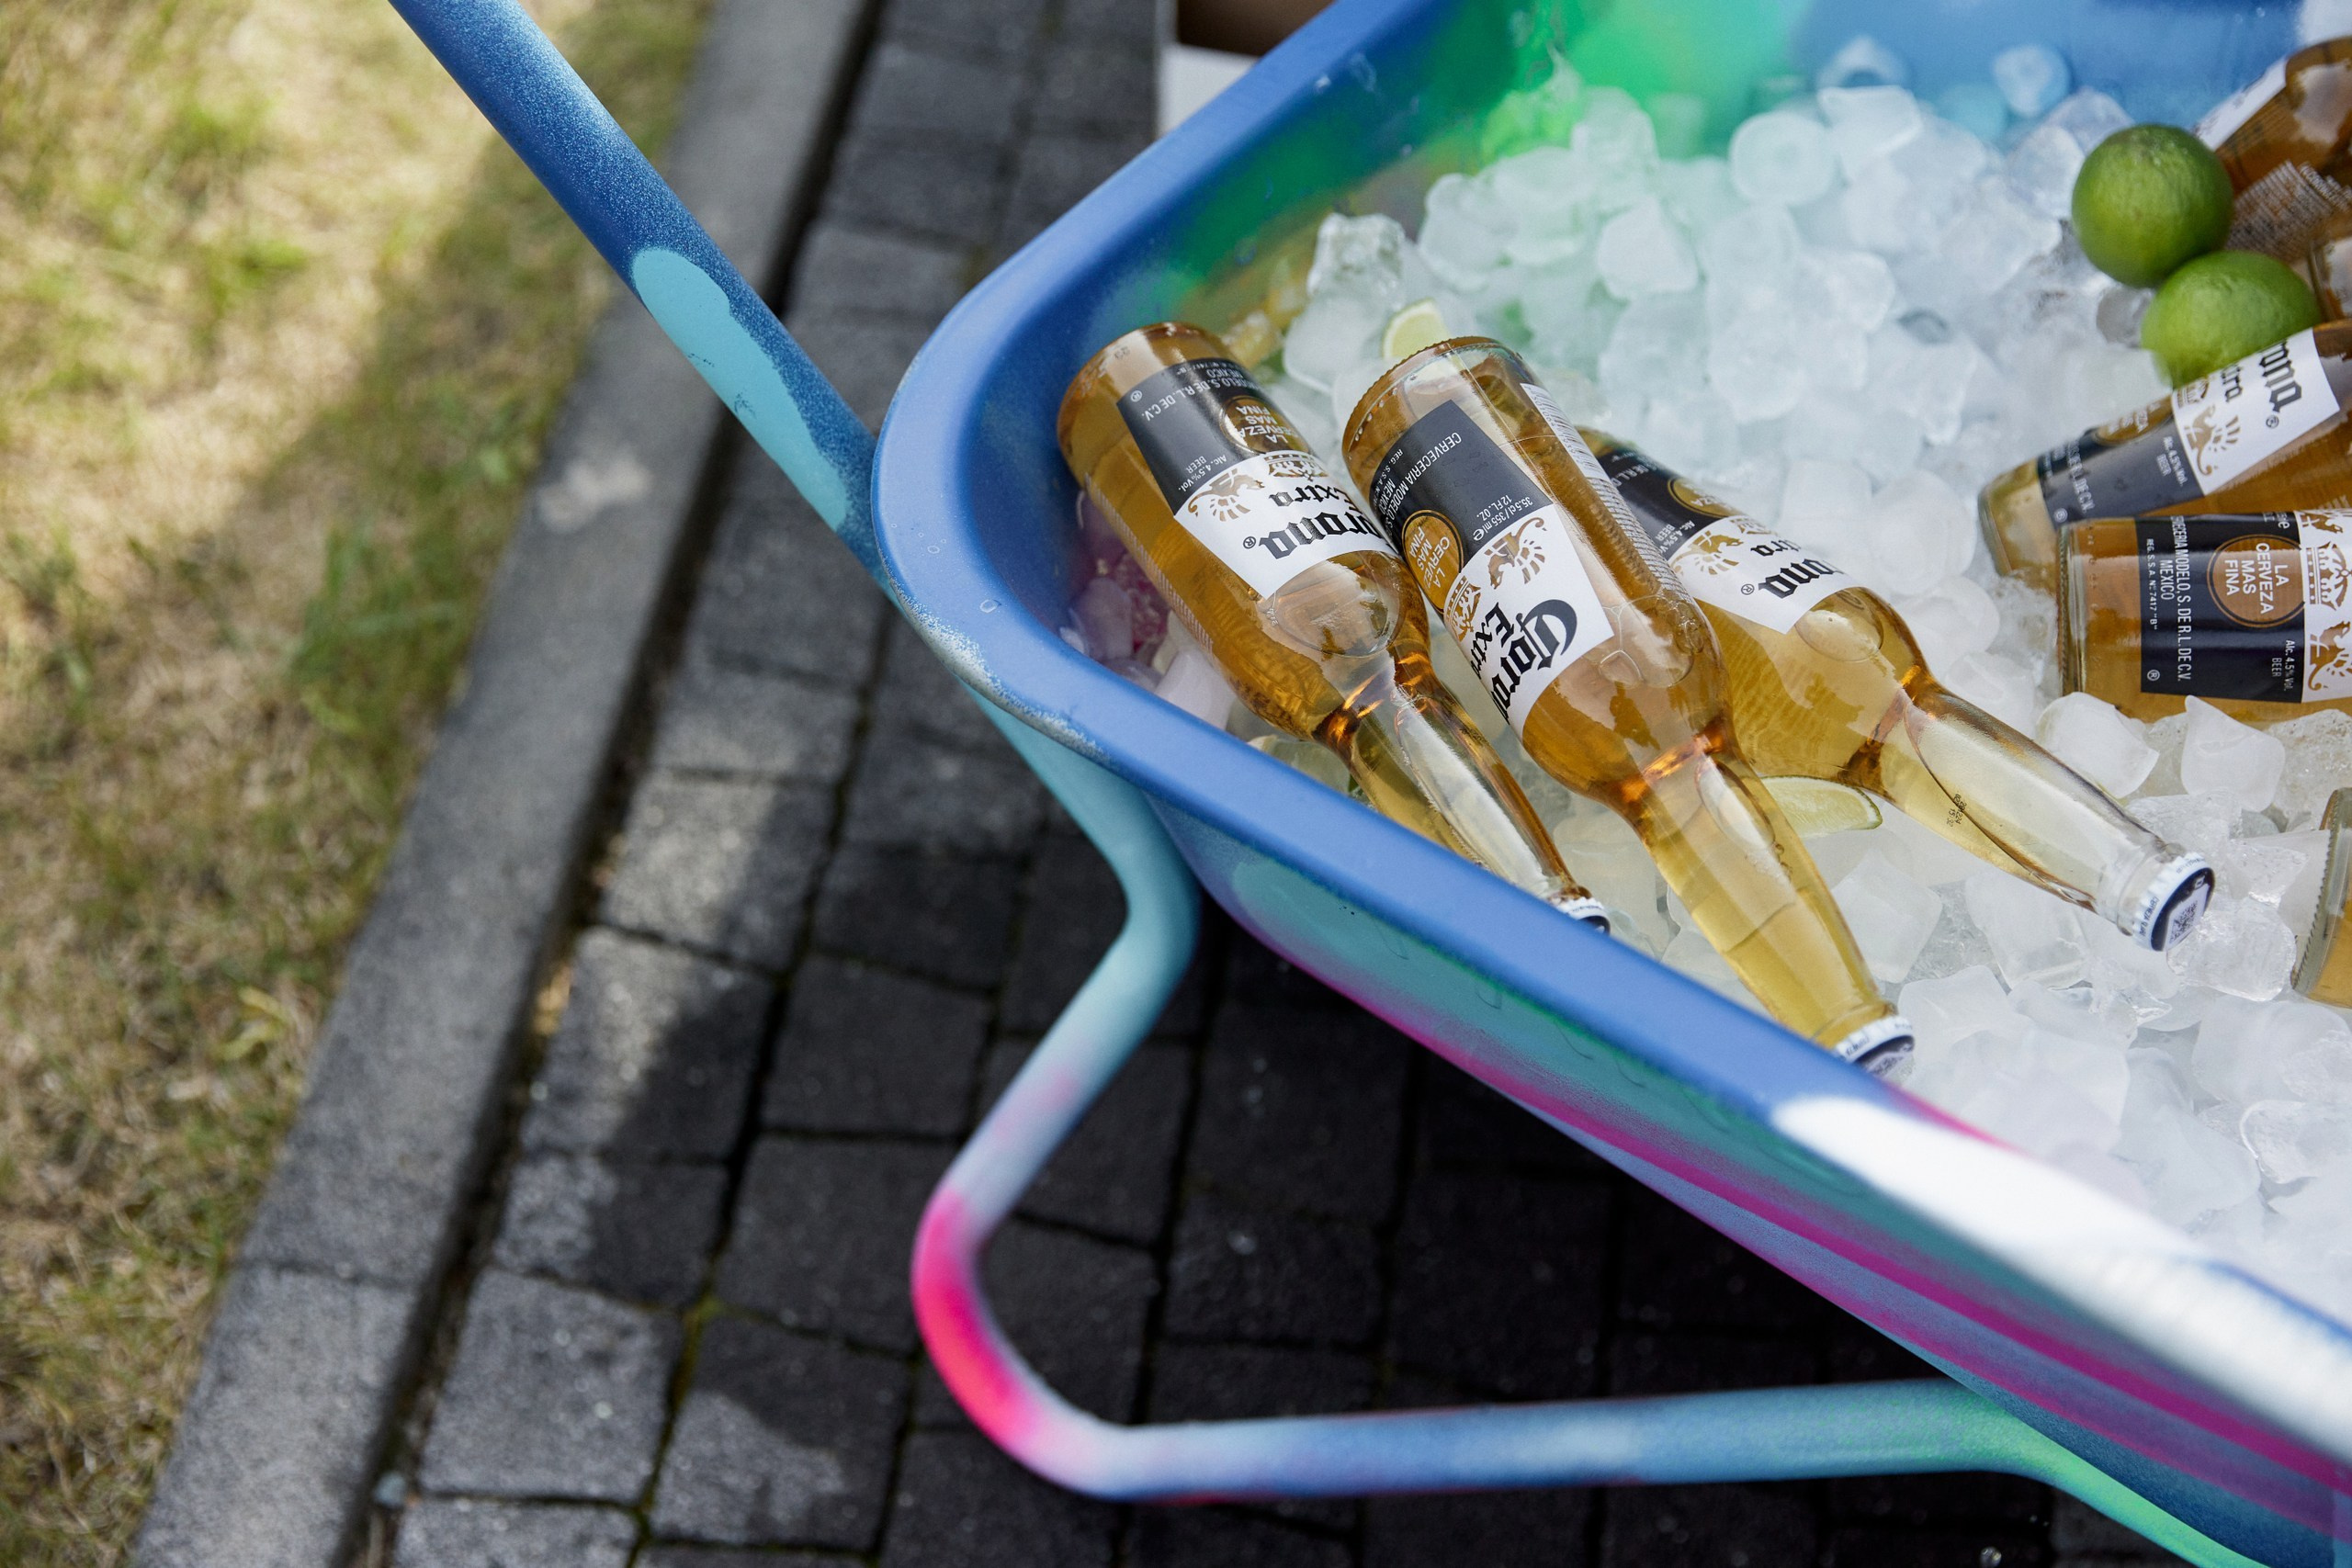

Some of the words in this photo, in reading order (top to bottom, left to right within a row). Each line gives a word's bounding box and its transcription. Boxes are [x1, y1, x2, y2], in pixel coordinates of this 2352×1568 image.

[1236, 406, 1270, 415] FINA
[1247, 415, 1278, 425] MAS
[1265, 433, 1289, 444] LA
[1185, 455, 1206, 474] BEER
[1405, 432, 1462, 485] CERVECERIA
[1408, 525, 1426, 558] FINA
[1656, 524, 1676, 542] BEER
[1417, 538, 1433, 571] MAS
[1433, 567, 1445, 588] LA
[2159, 559, 2176, 600] MEXICO
[2175, 548, 2191, 594] MODELO,
[2224, 559, 2240, 596] FINA
[2241, 559, 2257, 595] MAS
[2256, 542, 2275, 615] CERVEZA
[2274, 564, 2290, 587] LA
[2177, 608, 2192, 623] DE
[2177, 648, 2192, 662] DE
[2177, 663, 2192, 682] C.V.
[2271, 658, 2282, 678] BEER
